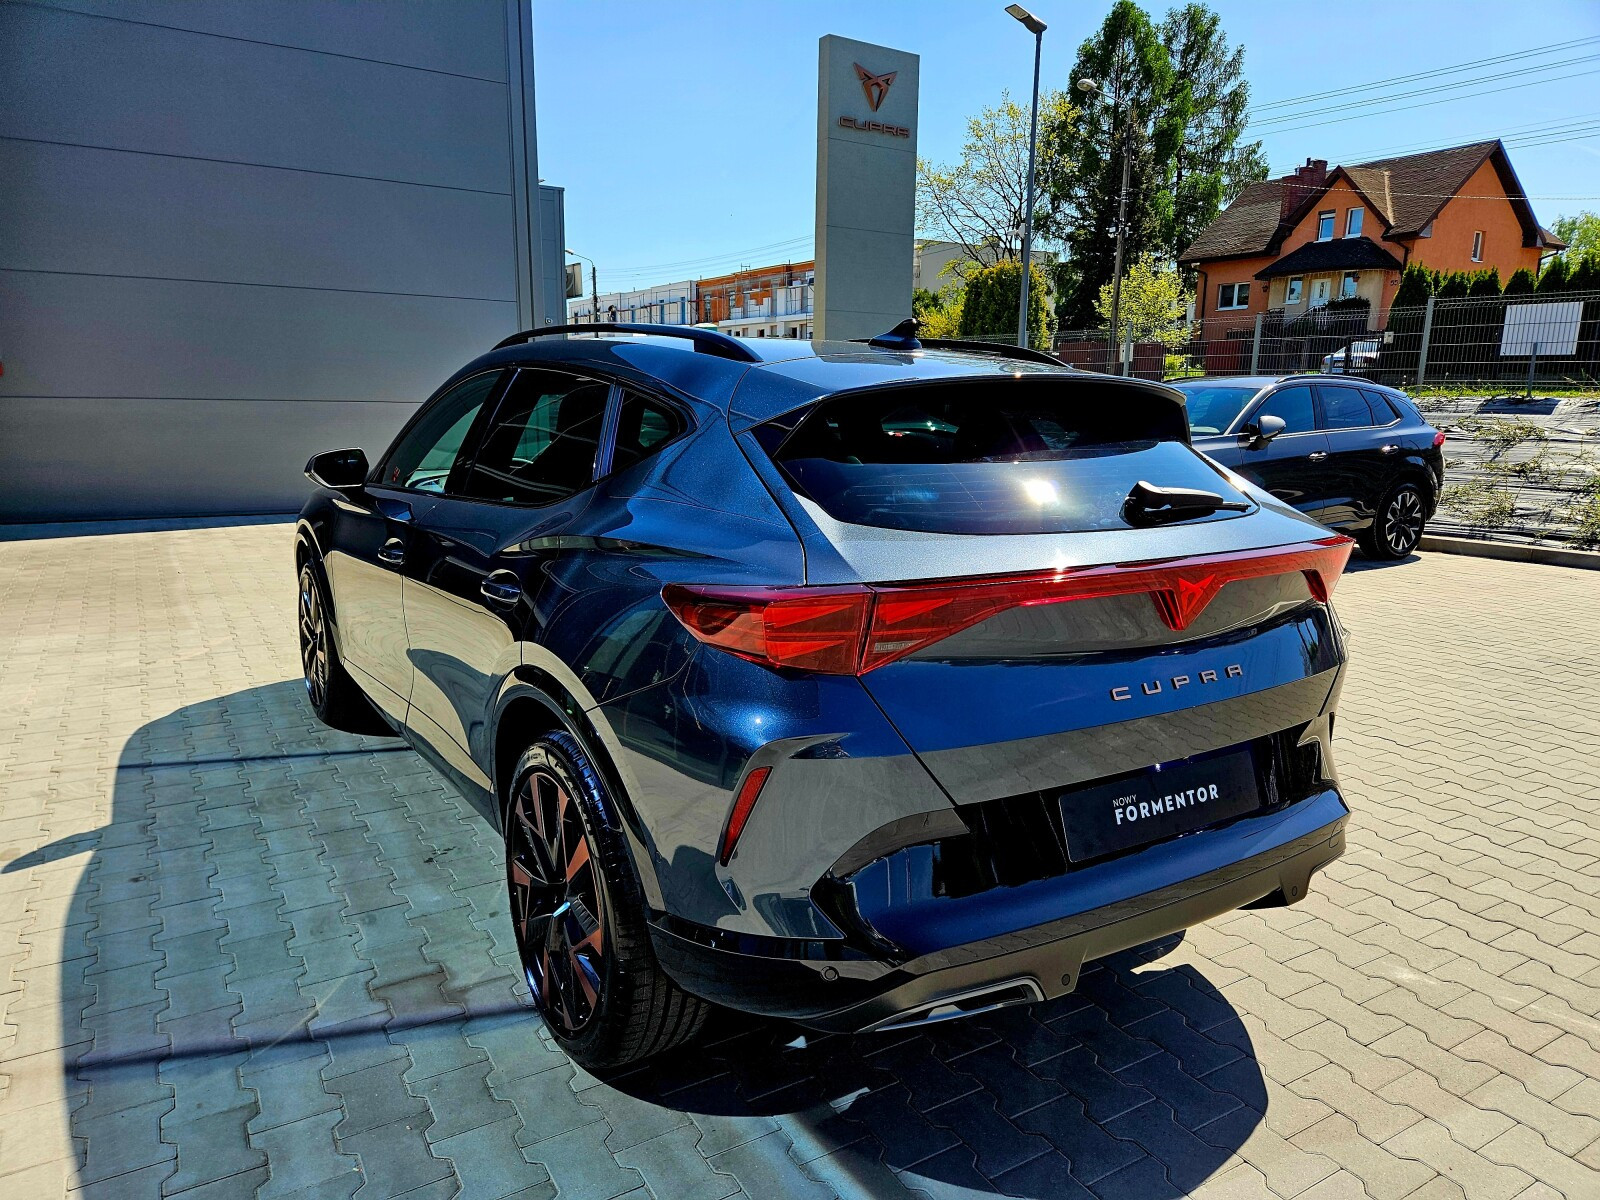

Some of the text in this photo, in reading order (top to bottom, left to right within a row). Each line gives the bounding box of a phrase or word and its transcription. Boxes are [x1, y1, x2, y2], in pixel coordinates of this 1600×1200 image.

[838, 115, 910, 139] CUPRA
[1110, 663, 1244, 701] CUPRA
[1112, 794, 1137, 808] NOWY
[1114, 783, 1219, 826] FORMENTOR
